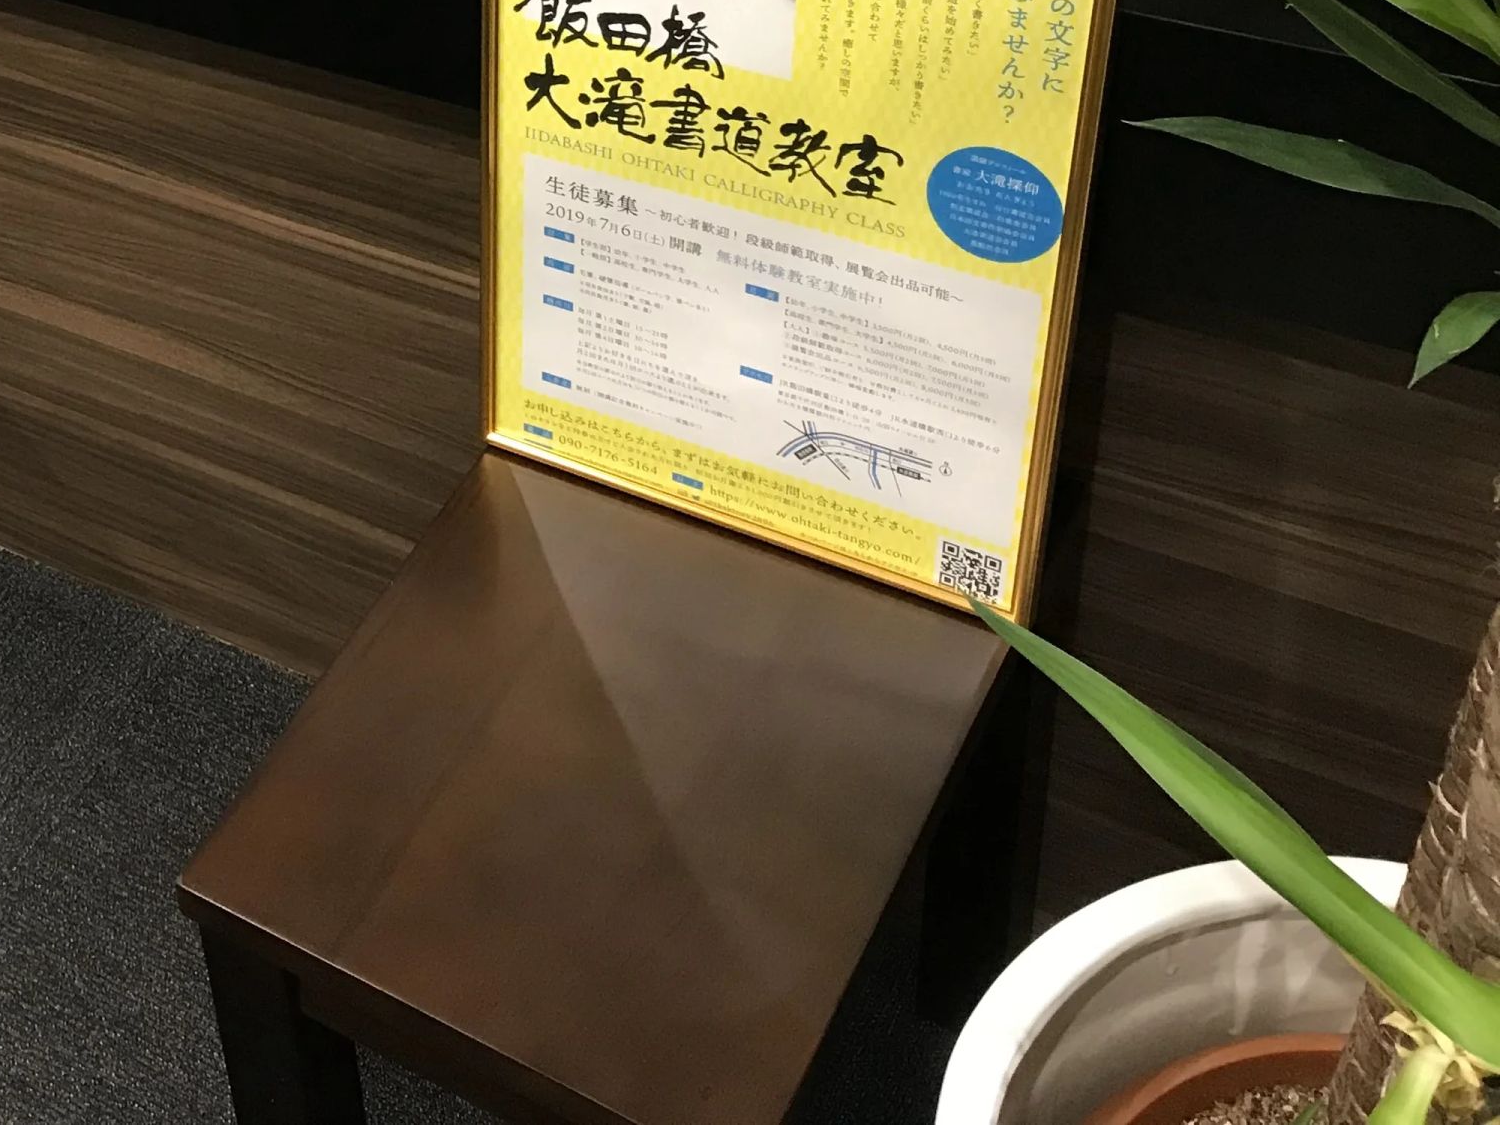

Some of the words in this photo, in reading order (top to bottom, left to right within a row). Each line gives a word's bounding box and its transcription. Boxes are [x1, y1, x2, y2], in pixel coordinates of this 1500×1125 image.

[523, 52, 905, 207] 大滝書道教室
[524, 123, 613, 162] IIDABASHI
[620, 149, 695, 183] OHTAKI
[703, 172, 838, 222] CALLIGRAPHY
[844, 210, 907, 240] CLASS
[544, 172, 639, 219] 生徒募集
[558, 432, 658, 477] 090-7176-5164
